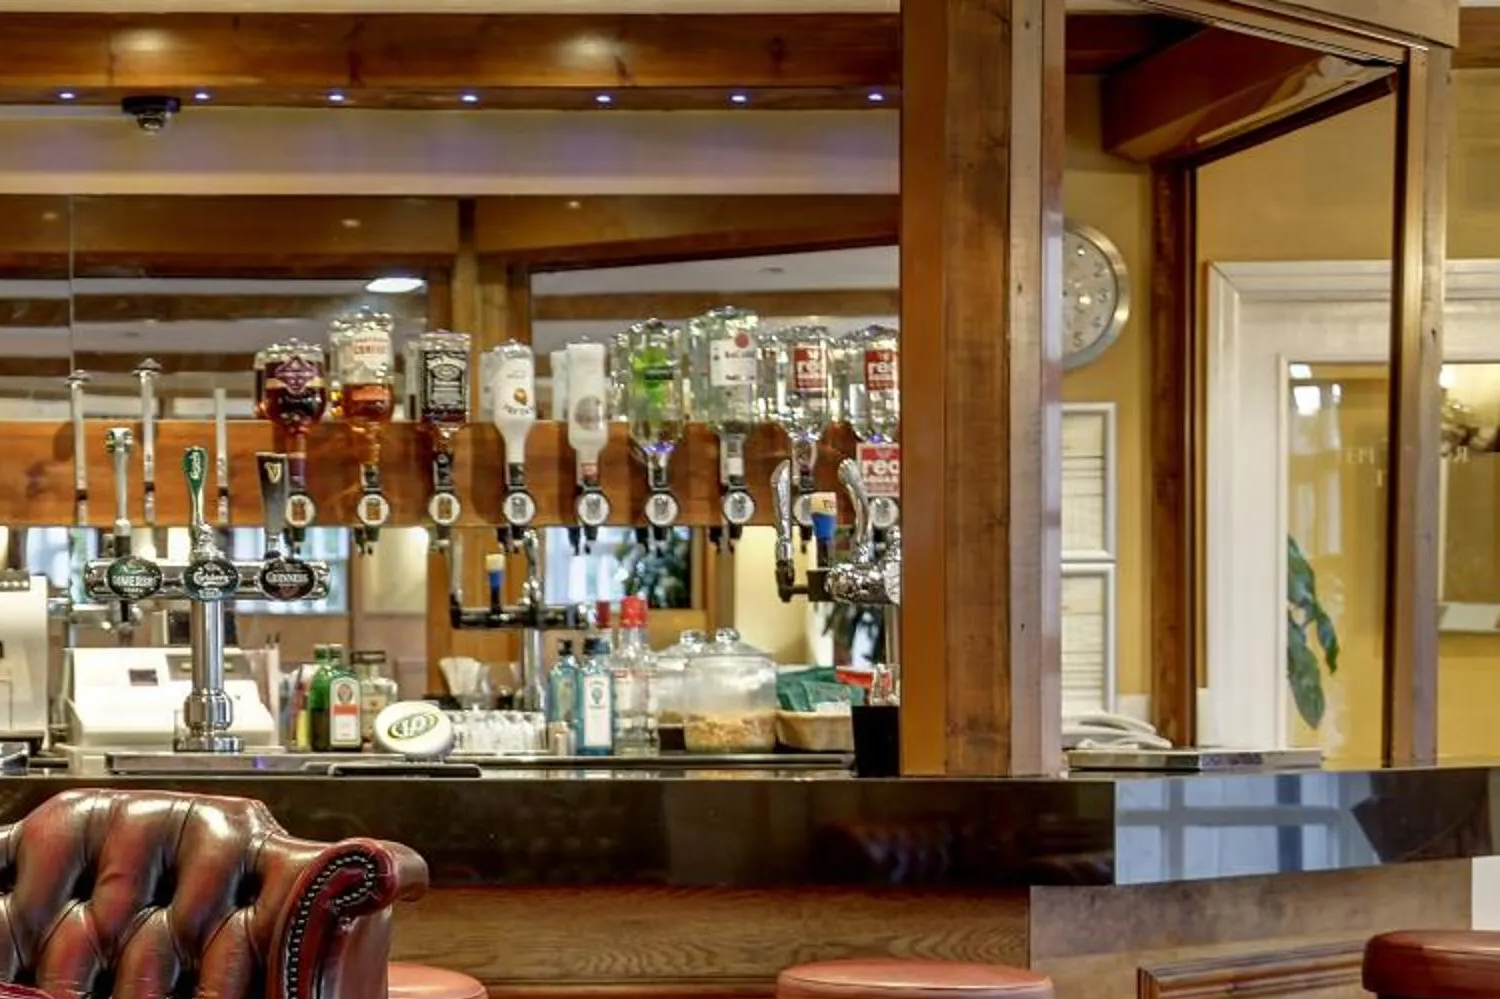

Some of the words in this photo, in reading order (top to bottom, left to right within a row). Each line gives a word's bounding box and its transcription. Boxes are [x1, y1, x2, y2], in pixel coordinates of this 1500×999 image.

[1093, 263, 1105, 279] 2
[1098, 288, 1109, 304] 3
[1073, 331, 1083, 348] 5
